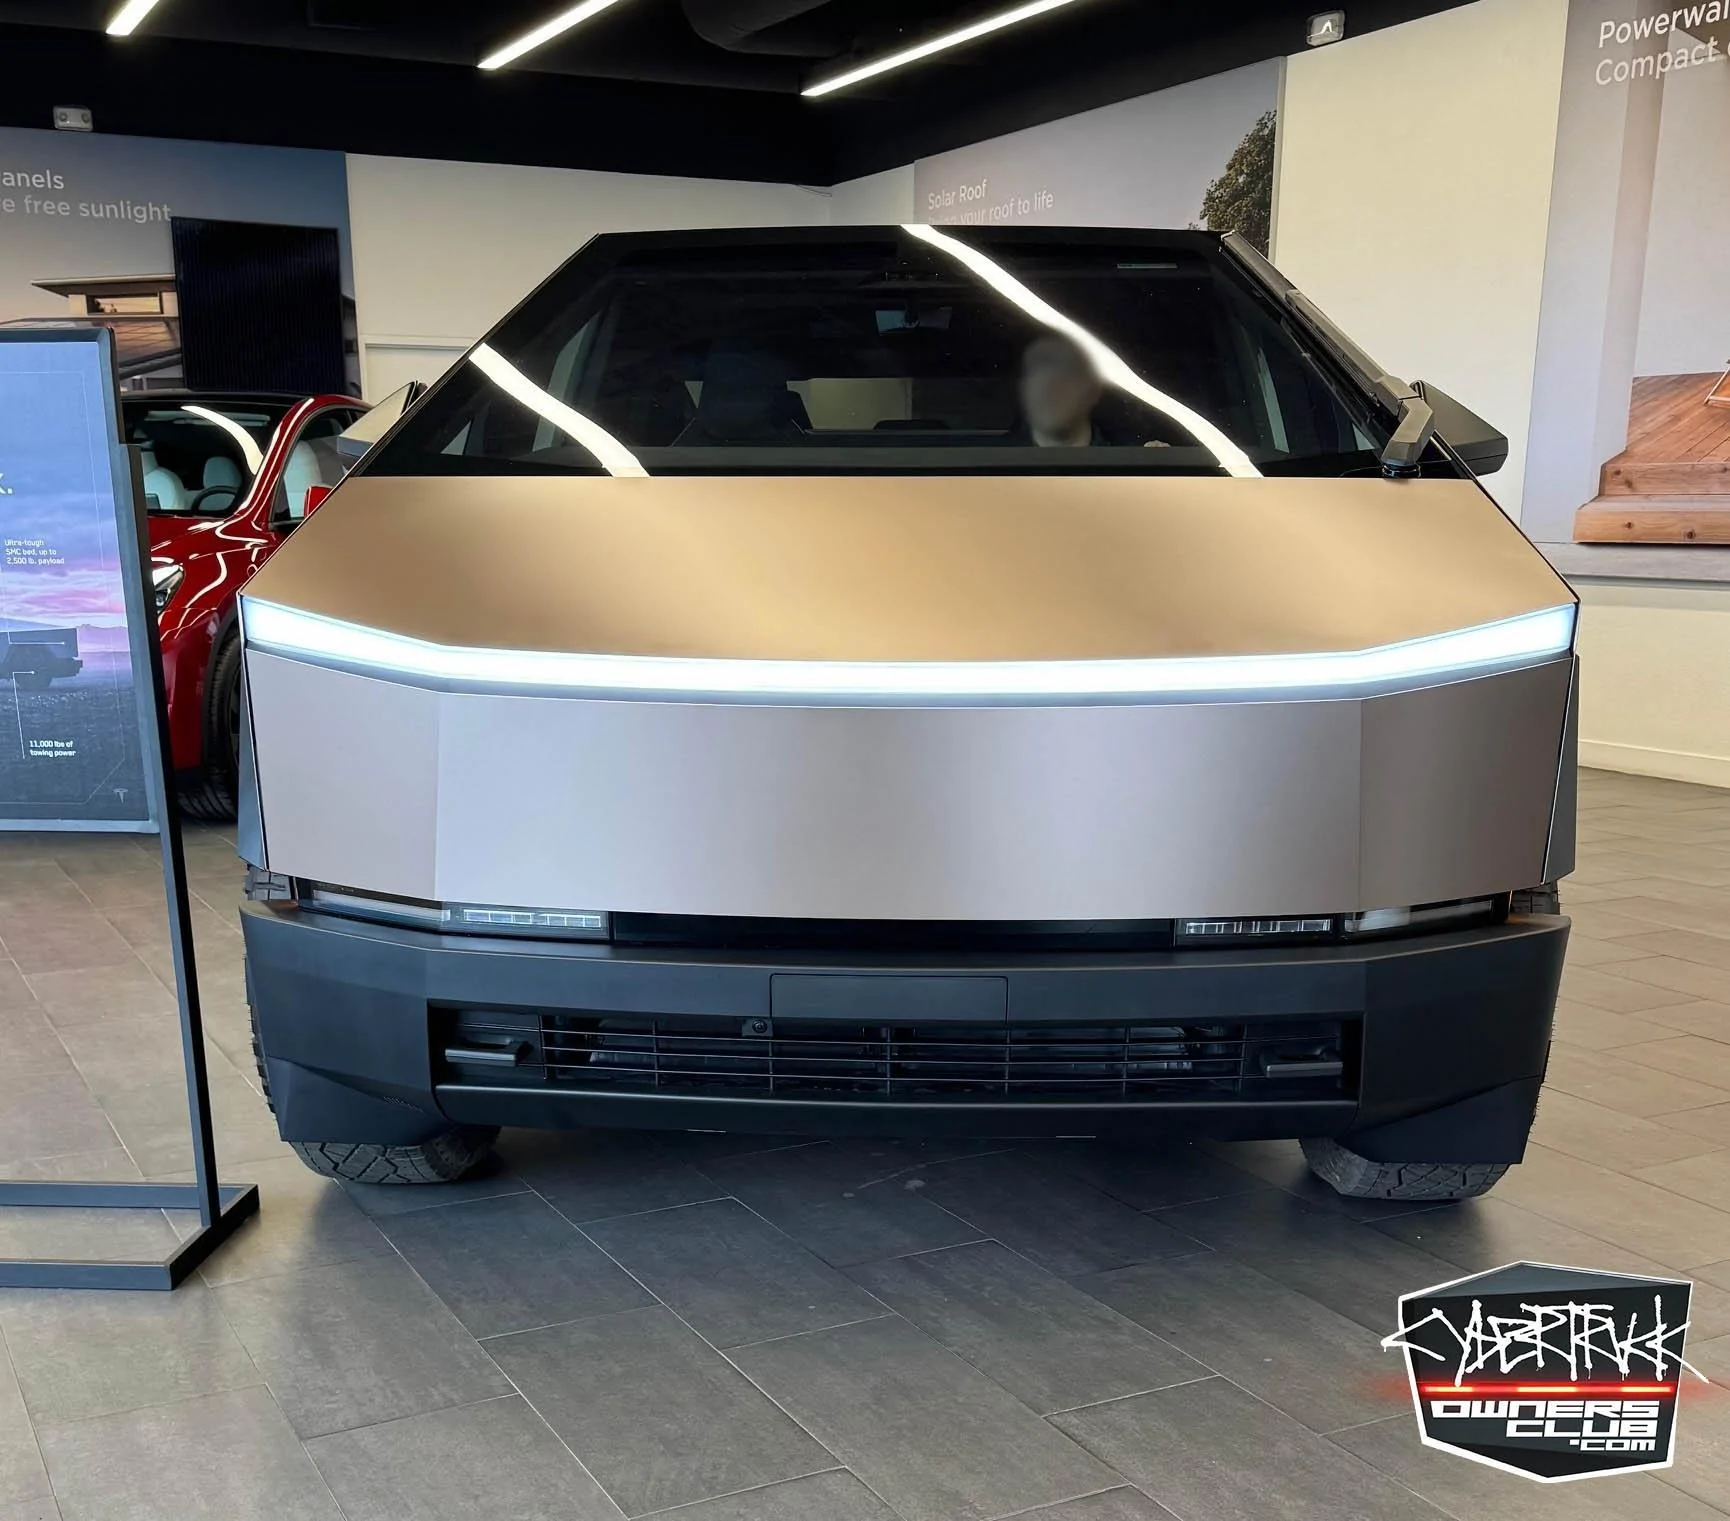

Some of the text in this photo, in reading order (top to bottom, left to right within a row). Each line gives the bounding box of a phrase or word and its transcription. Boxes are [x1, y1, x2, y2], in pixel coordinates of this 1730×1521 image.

[1599, 0, 1730, 48] Powerwal
[1596, 36, 1718, 85] Compact
[2, 169, 65, 190] anels
[24, 194, 70, 216] free
[79, 200, 172, 223] sunlight
[928, 179, 987, 210] Solar Roof
[989, 198, 1014, 220] roof
[1017, 199, 1030, 215] to
[1034, 190, 1054, 212] life
[38, 557, 65, 566] payload
[29, 740, 53, 748] 11,000
[65, 740, 74, 748] of
[29, 749, 53, 758] towing
